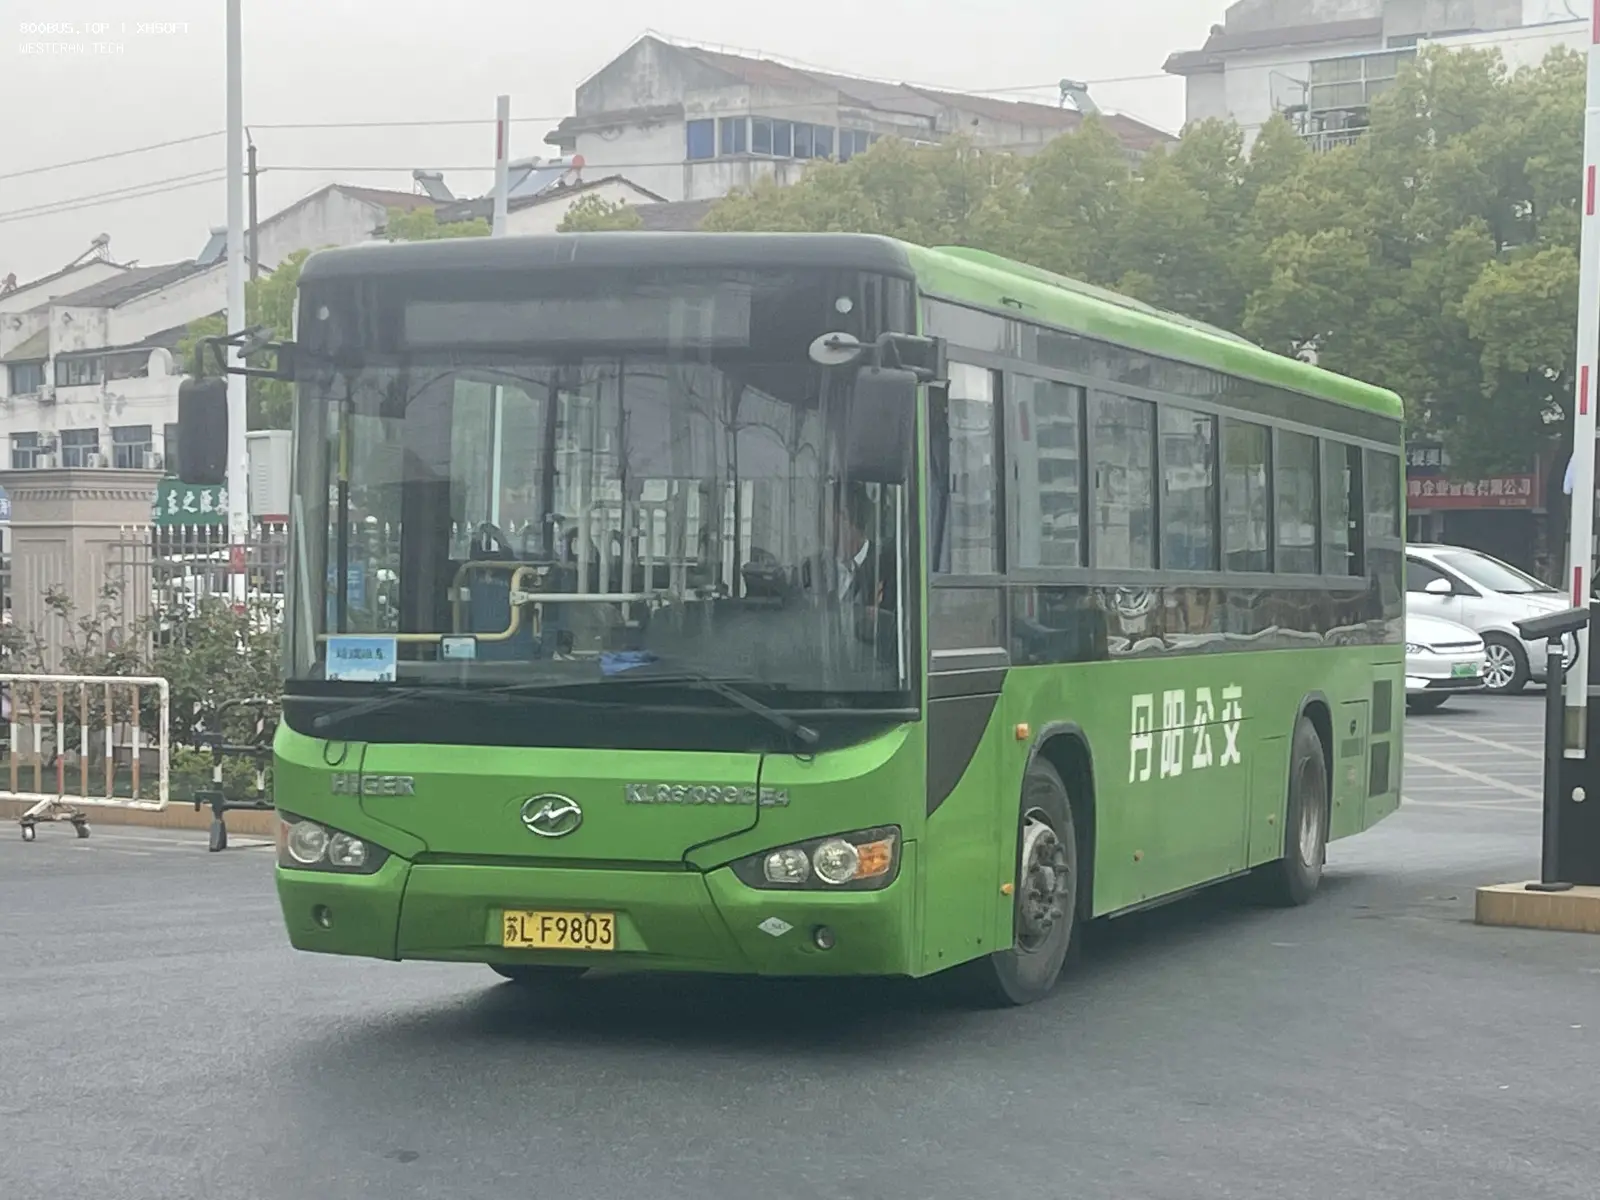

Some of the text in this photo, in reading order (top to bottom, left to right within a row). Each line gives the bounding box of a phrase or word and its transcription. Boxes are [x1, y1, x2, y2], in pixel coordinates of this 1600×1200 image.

[1129, 682, 1242, 784] 丹阳公交
[331, 772, 416, 796] HIGER
